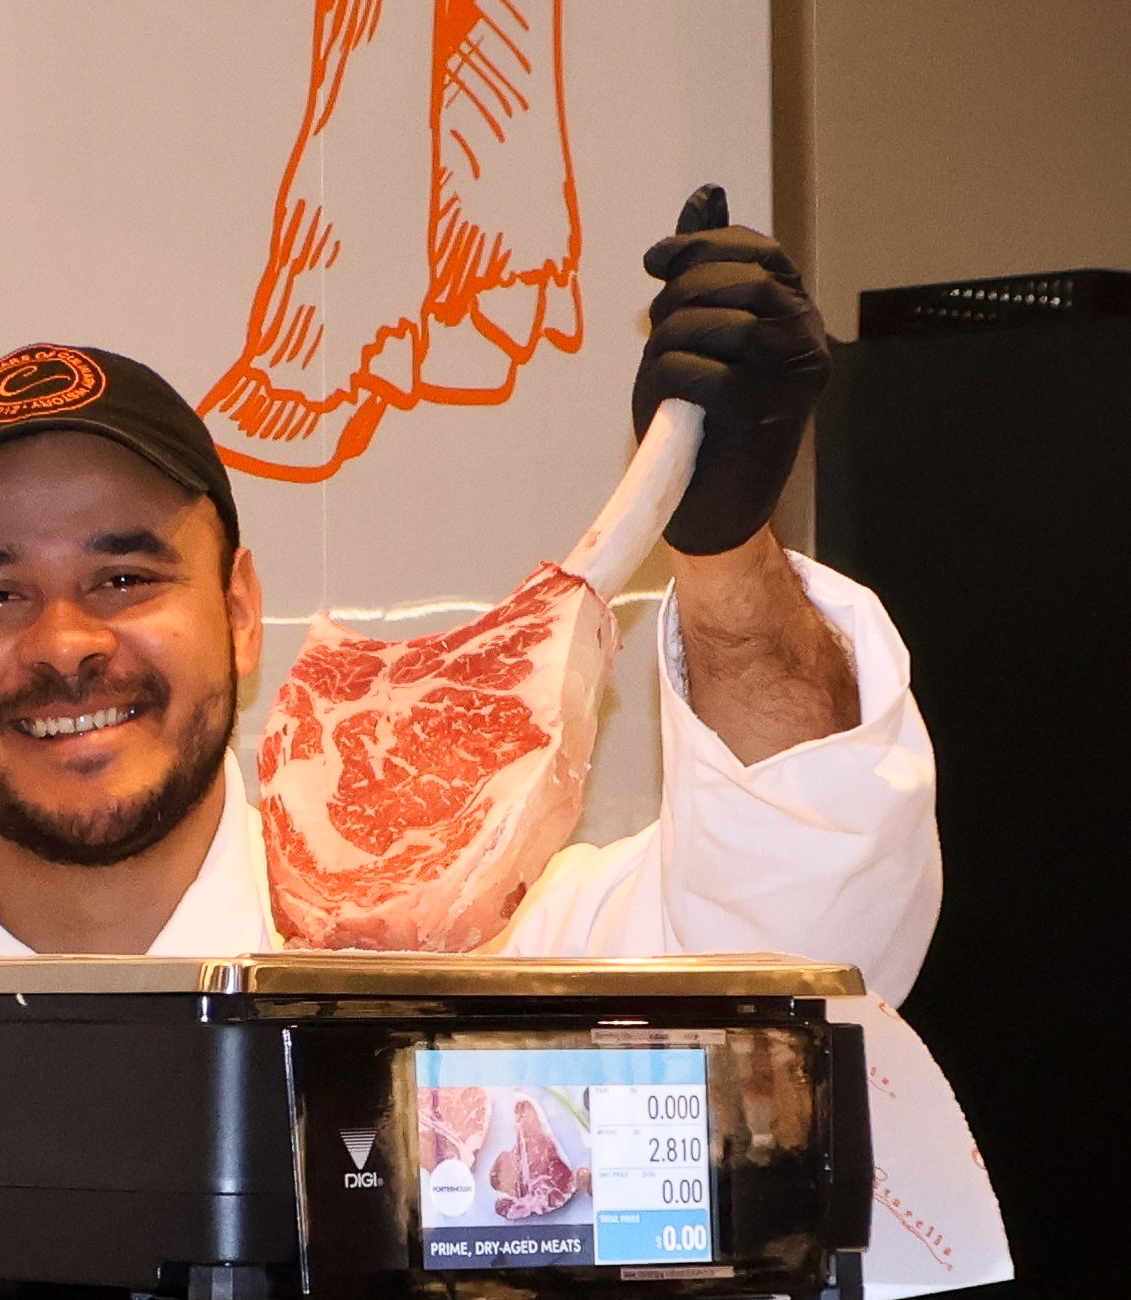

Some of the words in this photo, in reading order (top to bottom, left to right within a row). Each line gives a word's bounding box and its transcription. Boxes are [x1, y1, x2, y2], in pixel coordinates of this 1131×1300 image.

[648, 1095, 701, 1120] 0.000
[648, 1137, 702, 1163] 2.810
[344, 1172, 378, 1189] DIGI
[662, 1179, 703, 1204] 0.00
[430, 1240, 472, 1258] PRIME,
[475, 1238, 538, 1255] DRY-AGED
[540, 1238, 582, 1254] MEATS
